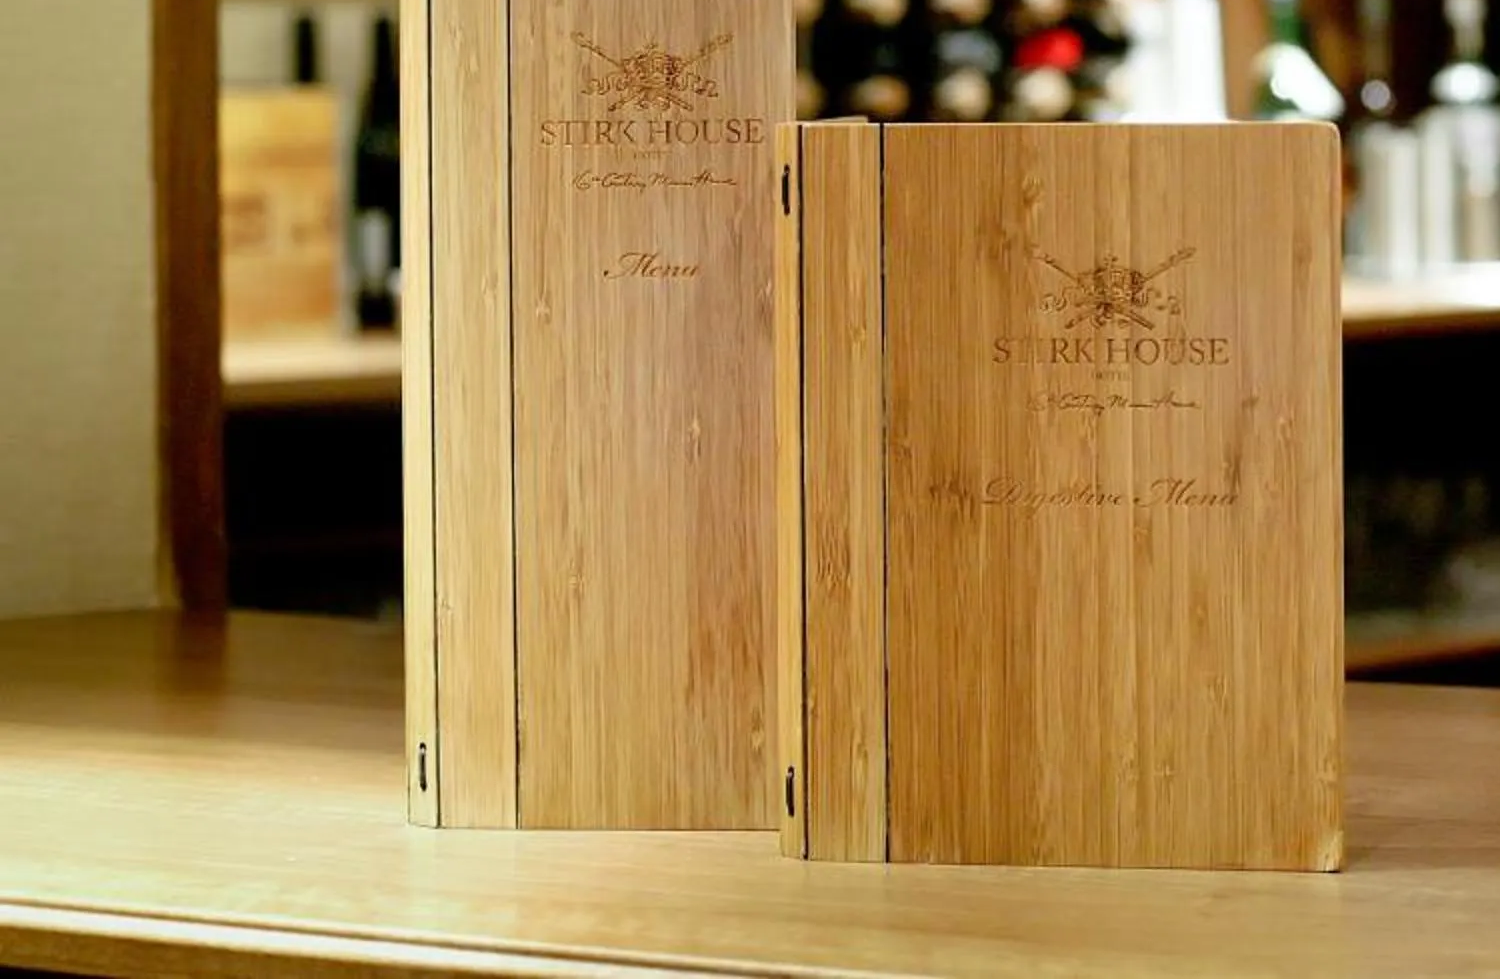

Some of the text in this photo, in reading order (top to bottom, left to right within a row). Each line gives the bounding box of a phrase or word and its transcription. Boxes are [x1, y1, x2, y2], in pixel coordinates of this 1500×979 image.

[540, 118, 765, 146] STIRK HOUSE
[603, 251, 701, 279] Menu
[1107, 338, 1230, 366] HOUSE
[1133, 477, 1238, 509] Menu
